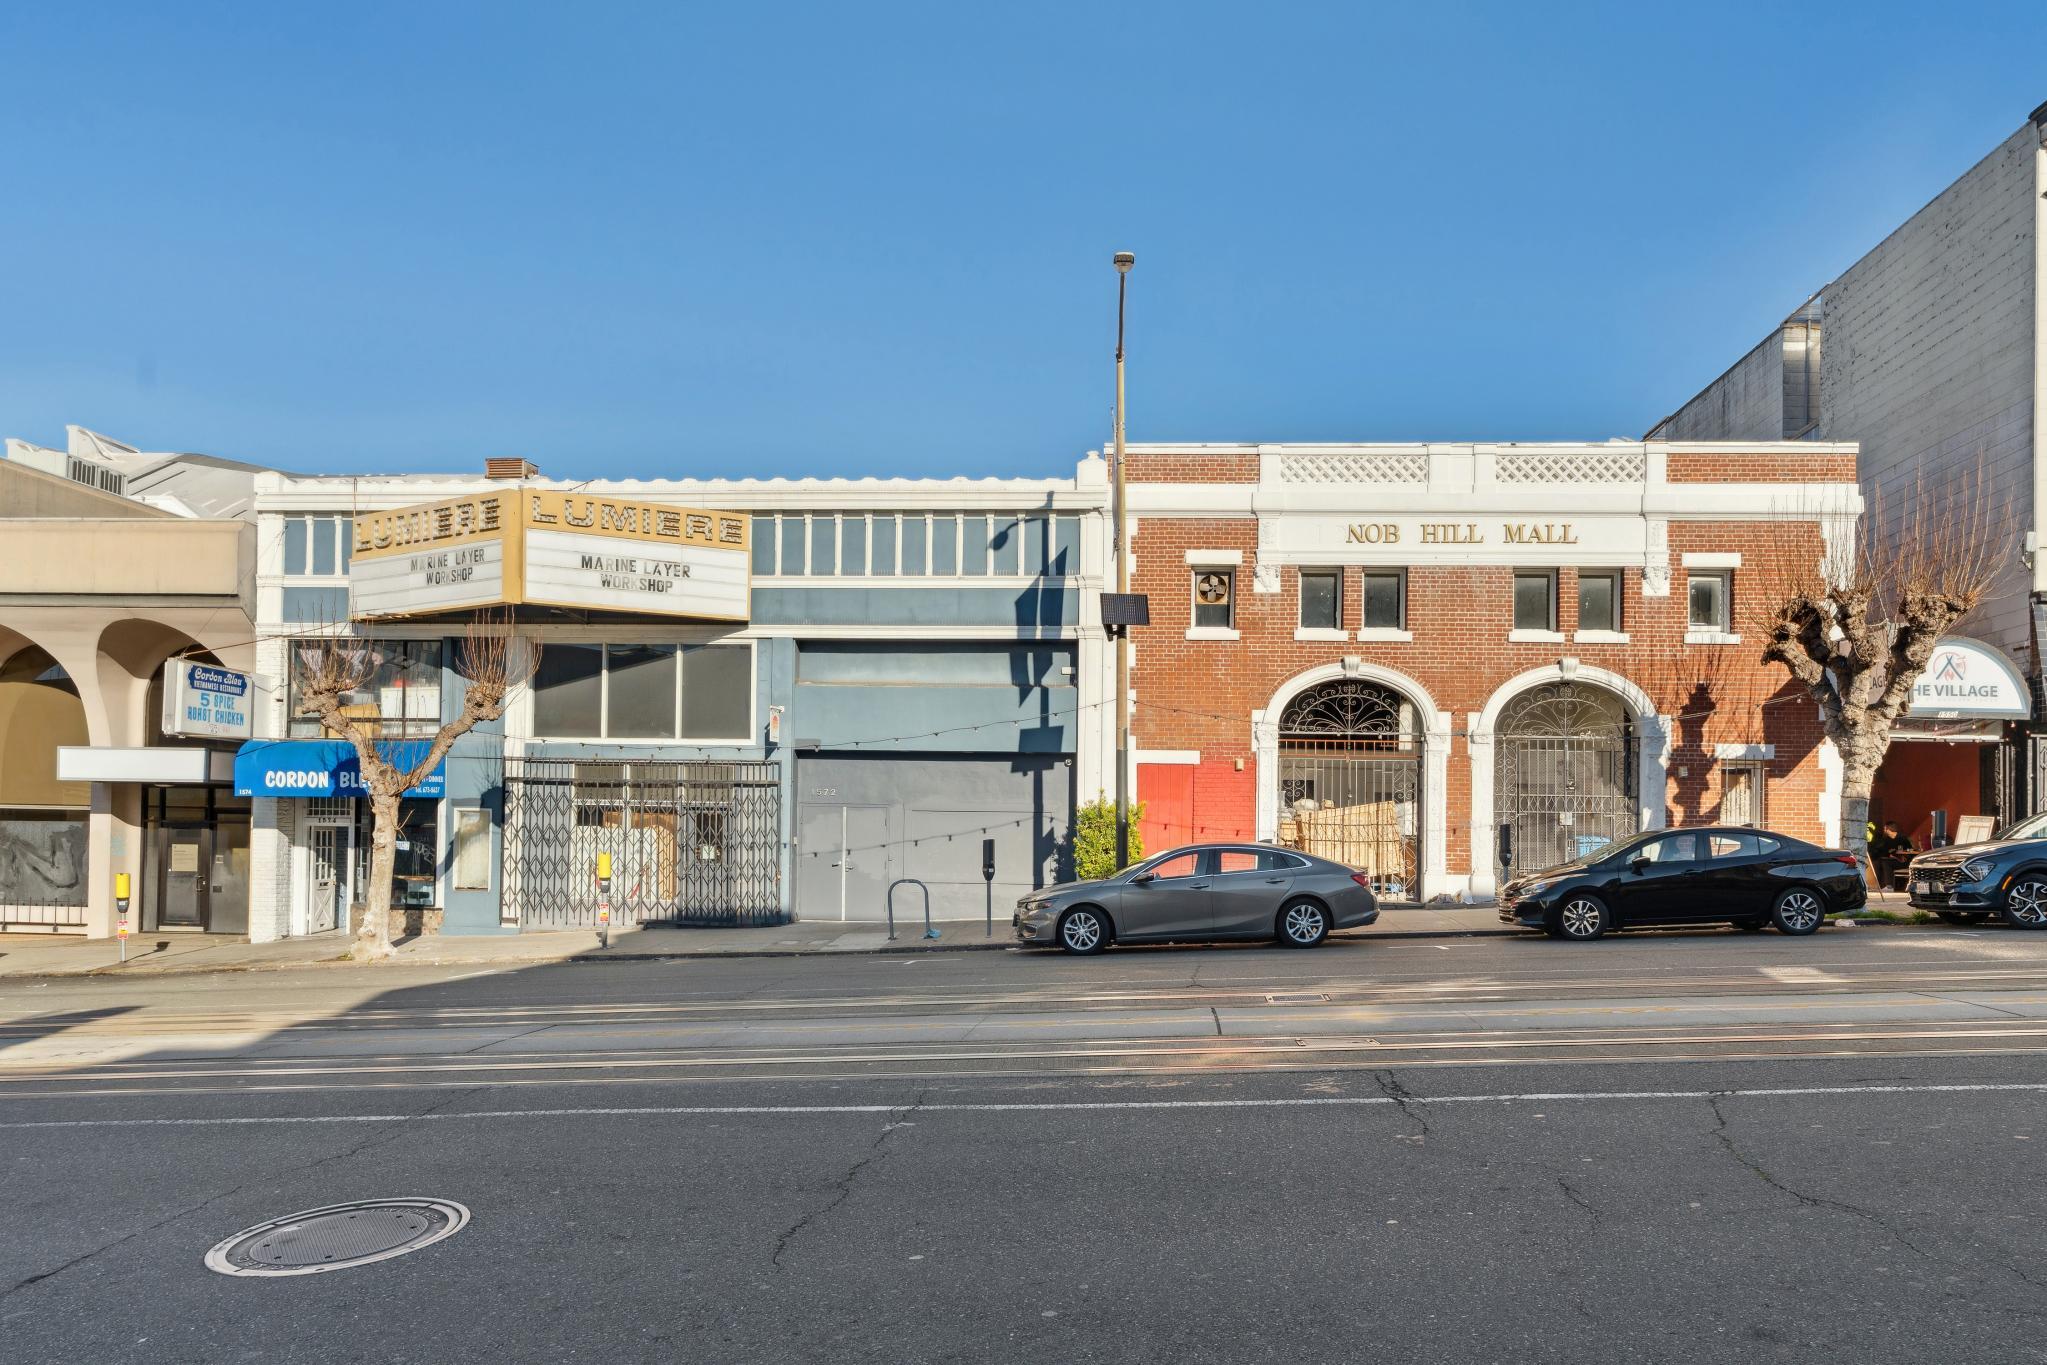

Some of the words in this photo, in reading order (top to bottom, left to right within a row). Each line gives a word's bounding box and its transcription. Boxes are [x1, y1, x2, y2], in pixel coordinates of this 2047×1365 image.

[355, 496, 502, 553] LUMIERE
[532, 495, 744, 545] LUMIERE
[1345, 523, 1401, 544] NOB
[1420, 524, 1484, 544] HILL
[1503, 524, 1579, 545] MALL
[410, 553, 448, 573] MARINE
[455, 548, 486, 567] LAYER
[580, 554, 637, 574] MARINE
[643, 560, 691, 579] LAYER
[426, 566, 474, 586] WORKSHOP
[600, 573, 674, 594] WORKSHOP
[194, 667, 222, 683] Cordon
[223, 674, 243, 686] Bleu
[200, 692, 210, 707] 5
[213, 694, 235, 710] SPICE
[1912, 685, 1930, 696] HE
[1934, 685, 1998, 697] VILLAGE
[187, 706, 212, 723] ROAST
[215, 709, 245, 726] CHICKEN
[265, 770, 329, 788] CORDON
